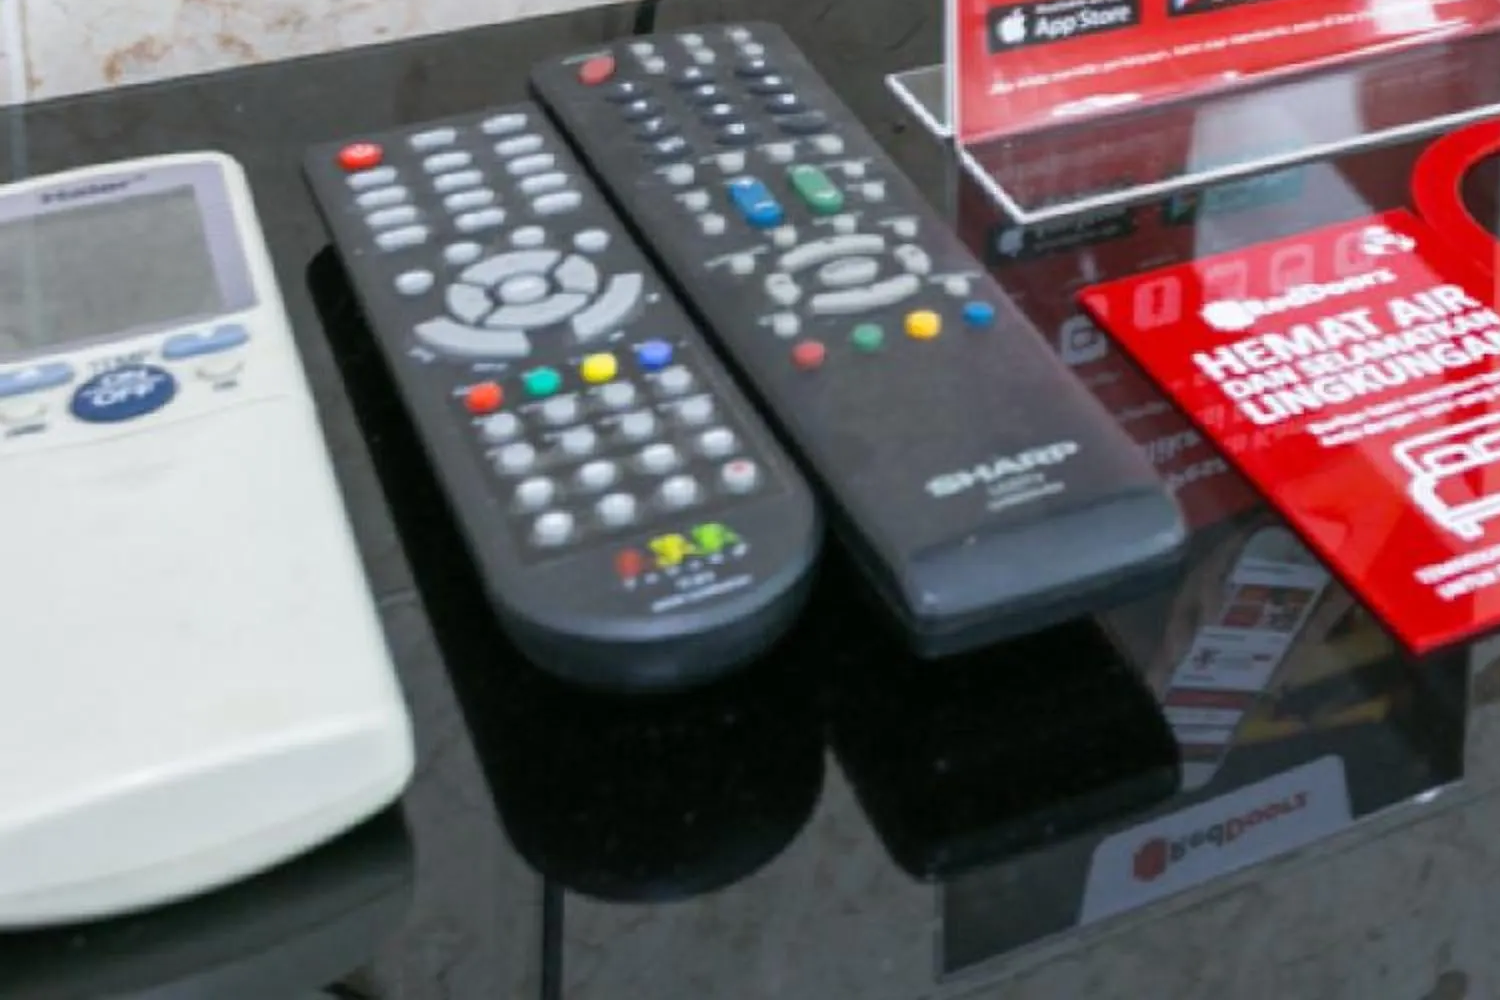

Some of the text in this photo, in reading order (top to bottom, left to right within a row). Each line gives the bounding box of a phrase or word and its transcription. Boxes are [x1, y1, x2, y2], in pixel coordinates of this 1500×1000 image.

[1034, 5, 1132, 37] App Store
[1192, 284, 1484, 380] HEMAT AIR
[1221, 364, 1298, 399] DAN
[924, 440, 1080, 497] SHARP
